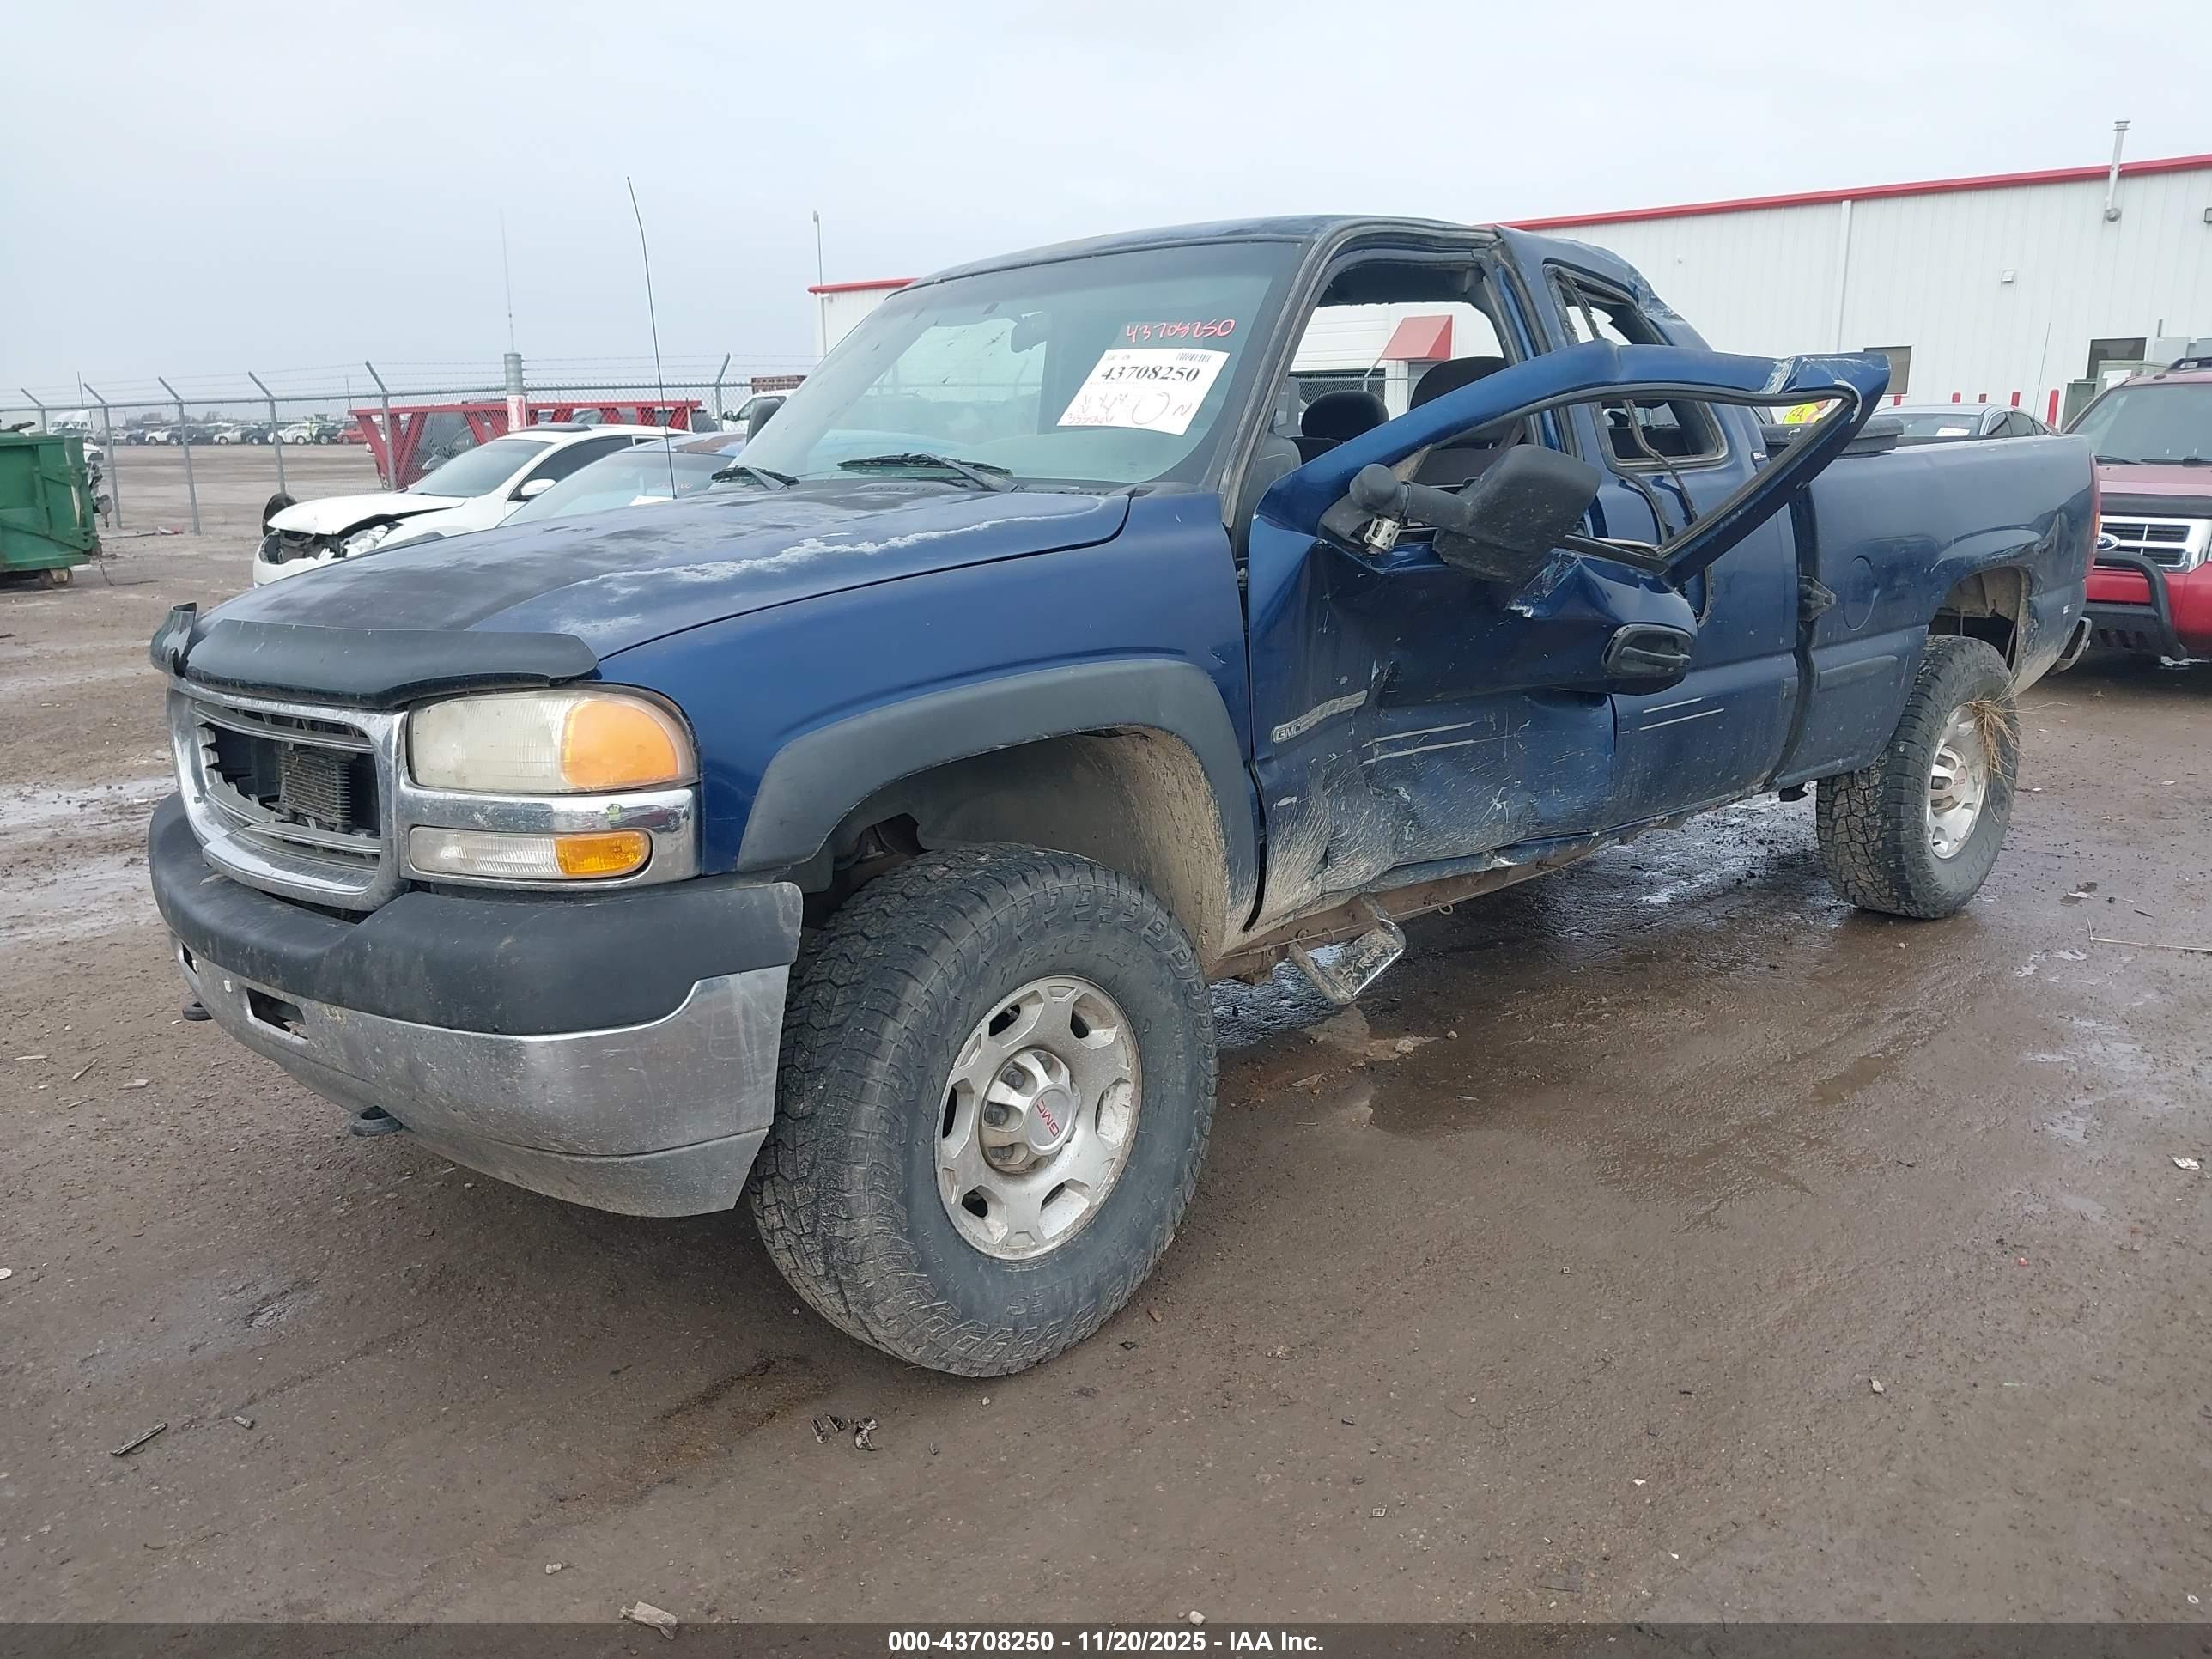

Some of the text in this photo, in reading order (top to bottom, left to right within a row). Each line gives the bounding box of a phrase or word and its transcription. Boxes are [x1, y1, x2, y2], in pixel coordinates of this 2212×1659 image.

[1102, 365, 1200, 382] 43708250
[1276, 723, 1301, 740] GMC
[1036, 1098, 1060, 1138] GMC
